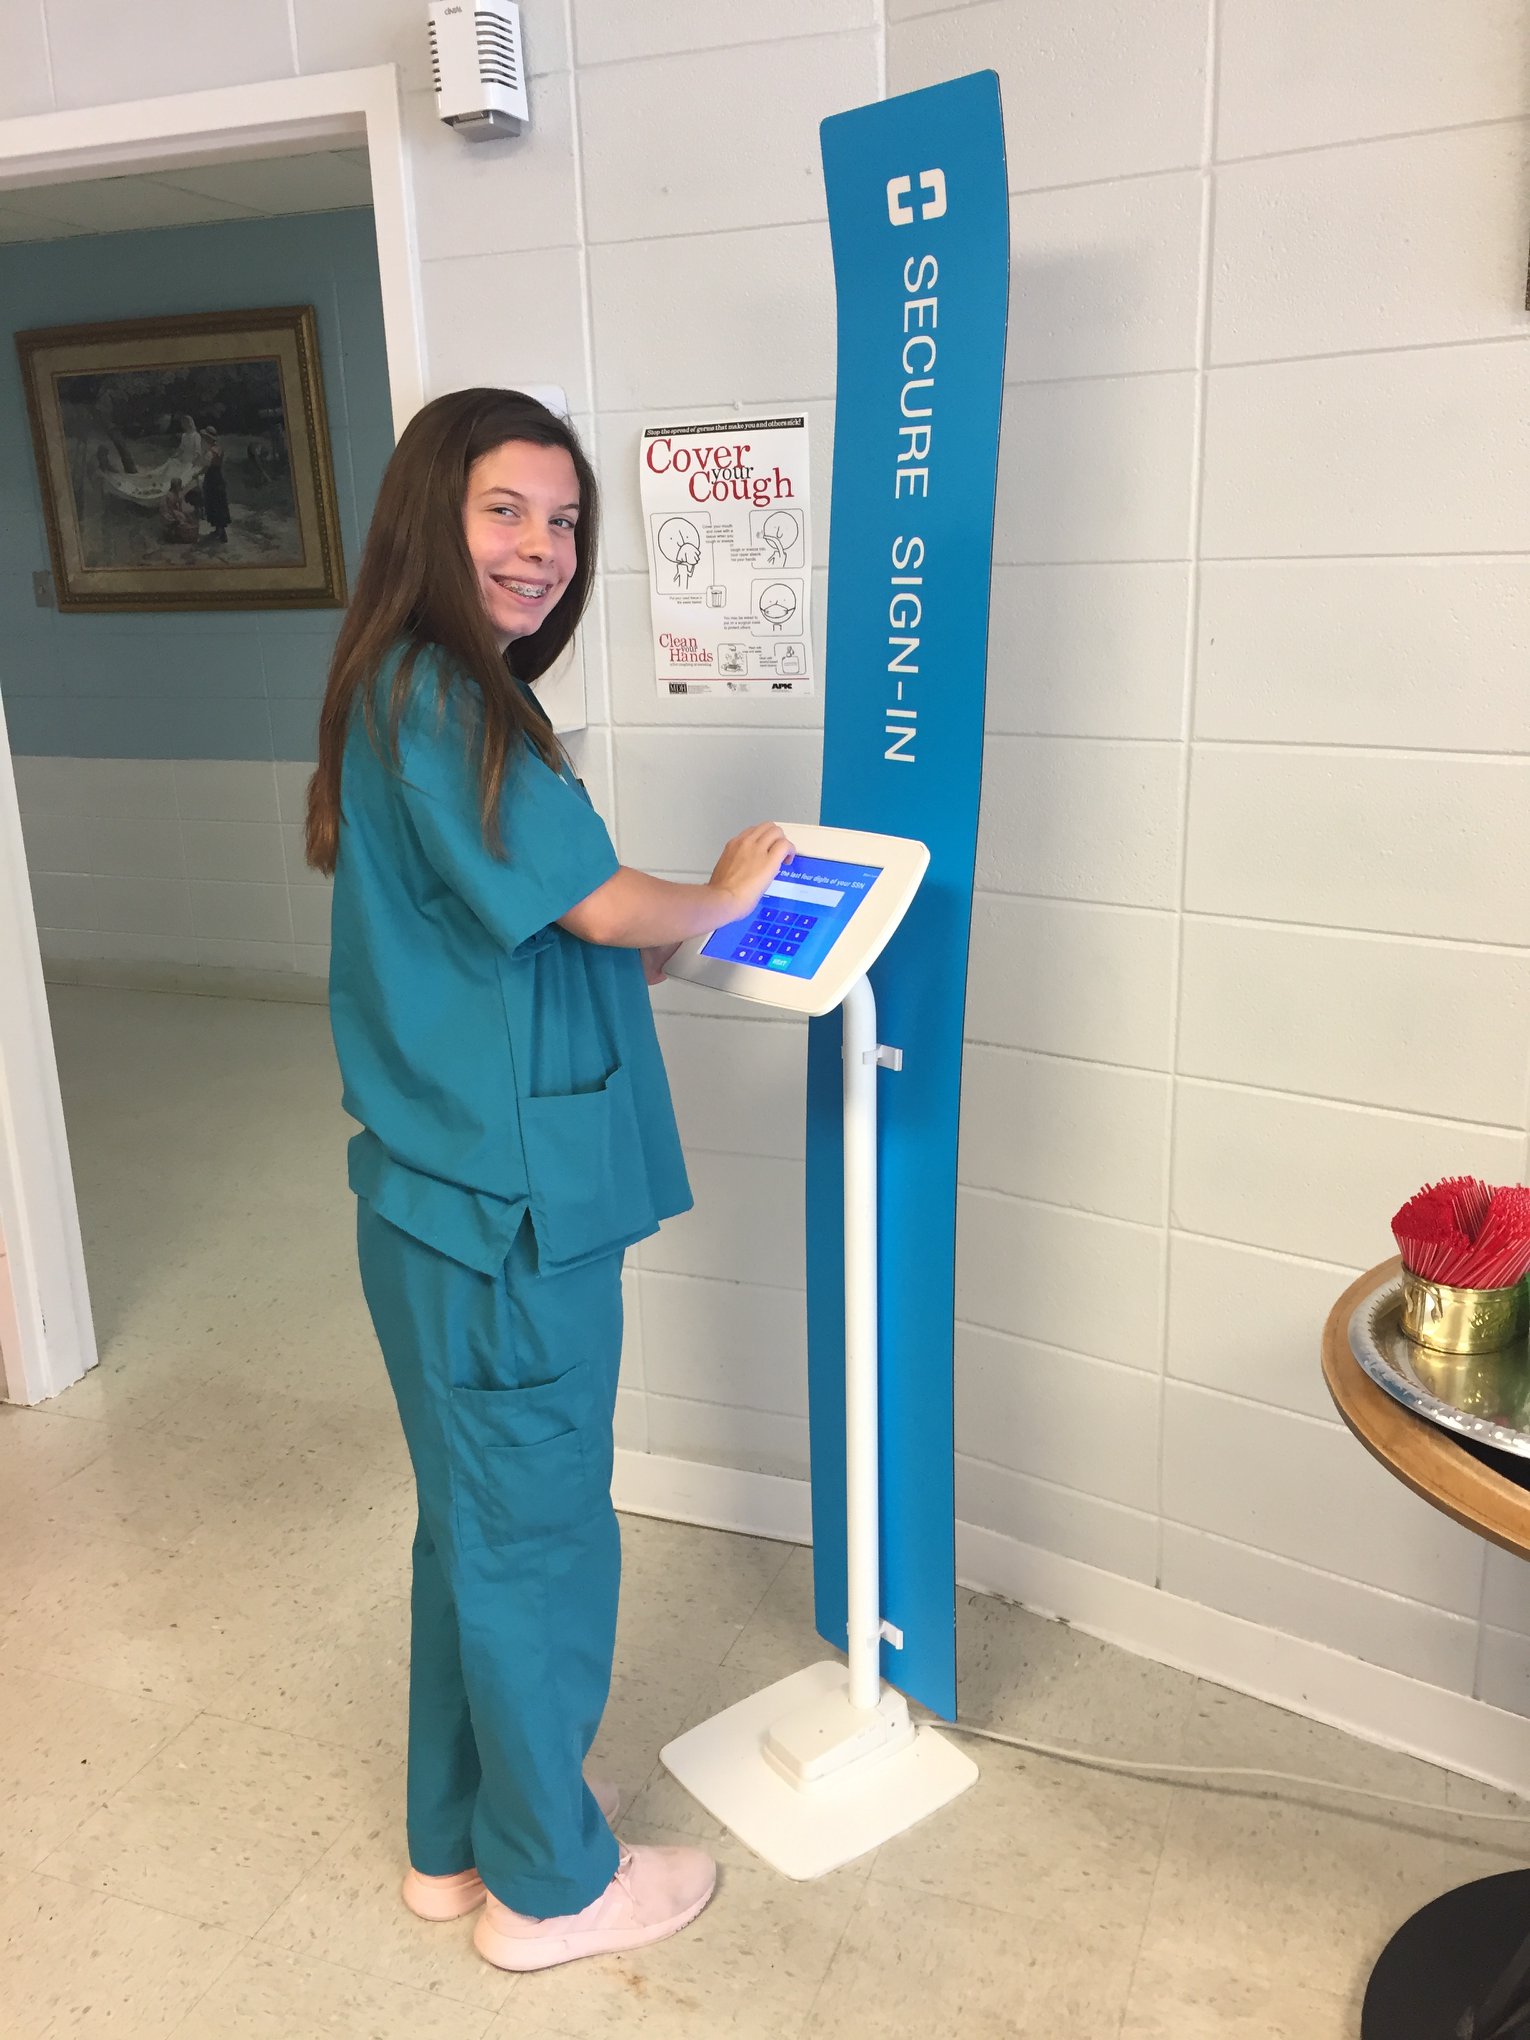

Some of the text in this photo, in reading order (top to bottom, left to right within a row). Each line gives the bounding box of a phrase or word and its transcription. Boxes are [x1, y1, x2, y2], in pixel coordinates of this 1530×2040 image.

[647, 429, 660, 437] Stop
[670, 426, 690, 435] spread
[696, 425, 714, 433] germs
[715, 423, 727, 431] that
[744, 422, 756, 430] you
[756, 420, 768, 428] and
[768, 419, 788, 427] others
[787, 418, 801, 426] sick!
[646, 438, 751, 474] Cover
[711, 466, 754, 485] your
[688, 467, 795, 507] Cough
[884, 254, 939, 763] SECURE SIGN-IN
[659, 633, 698, 648] Clean
[669, 648, 714, 662] Hands
[790, 871, 801, 879] last
[801, 873, 814, 882] four
[813, 875, 830, 885] digits
[836, 880, 852, 888] your
[851, 882, 866, 890] SSN
